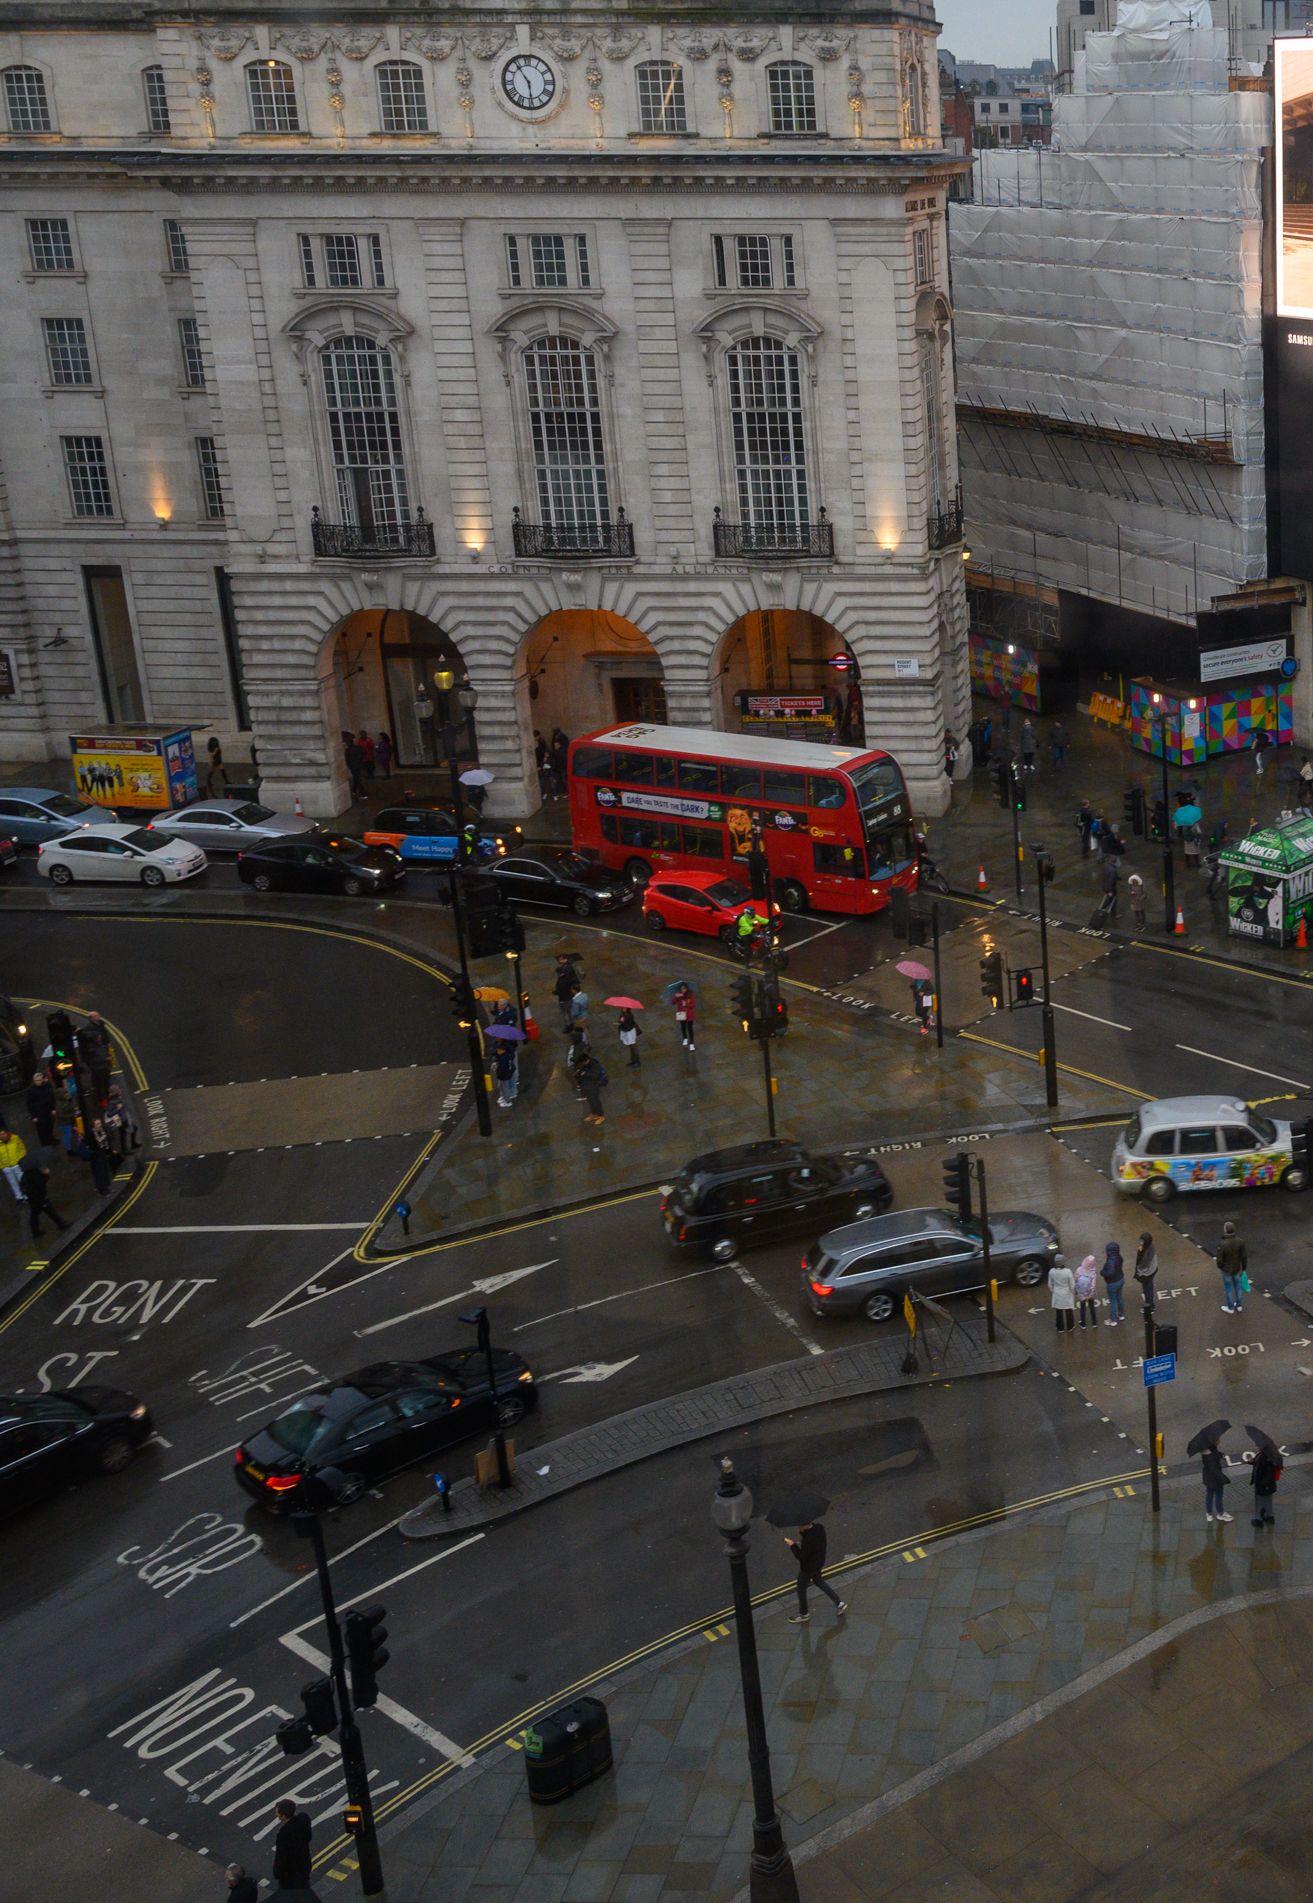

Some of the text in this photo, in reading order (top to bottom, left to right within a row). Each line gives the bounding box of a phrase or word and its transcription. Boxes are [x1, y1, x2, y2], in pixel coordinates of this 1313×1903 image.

[1076, 926, 1112, 939] LOOK
[832, 993, 923, 1024] LOOK LEF
[438, 1069, 473, 1113] LOOK LEFT
[144, 1095, 171, 1140] LOOK RIGHT
[867, 1132, 990, 1156] LOOK RIGHT
[54, 1278, 217, 1326] RGNT
[1205, 1341, 1265, 1359] LOOK
[35, 1351, 119, 1393] ST
[1224, 1445, 1290, 1467] LOK
[106, 1667, 399, 1843] NO ENTRY
